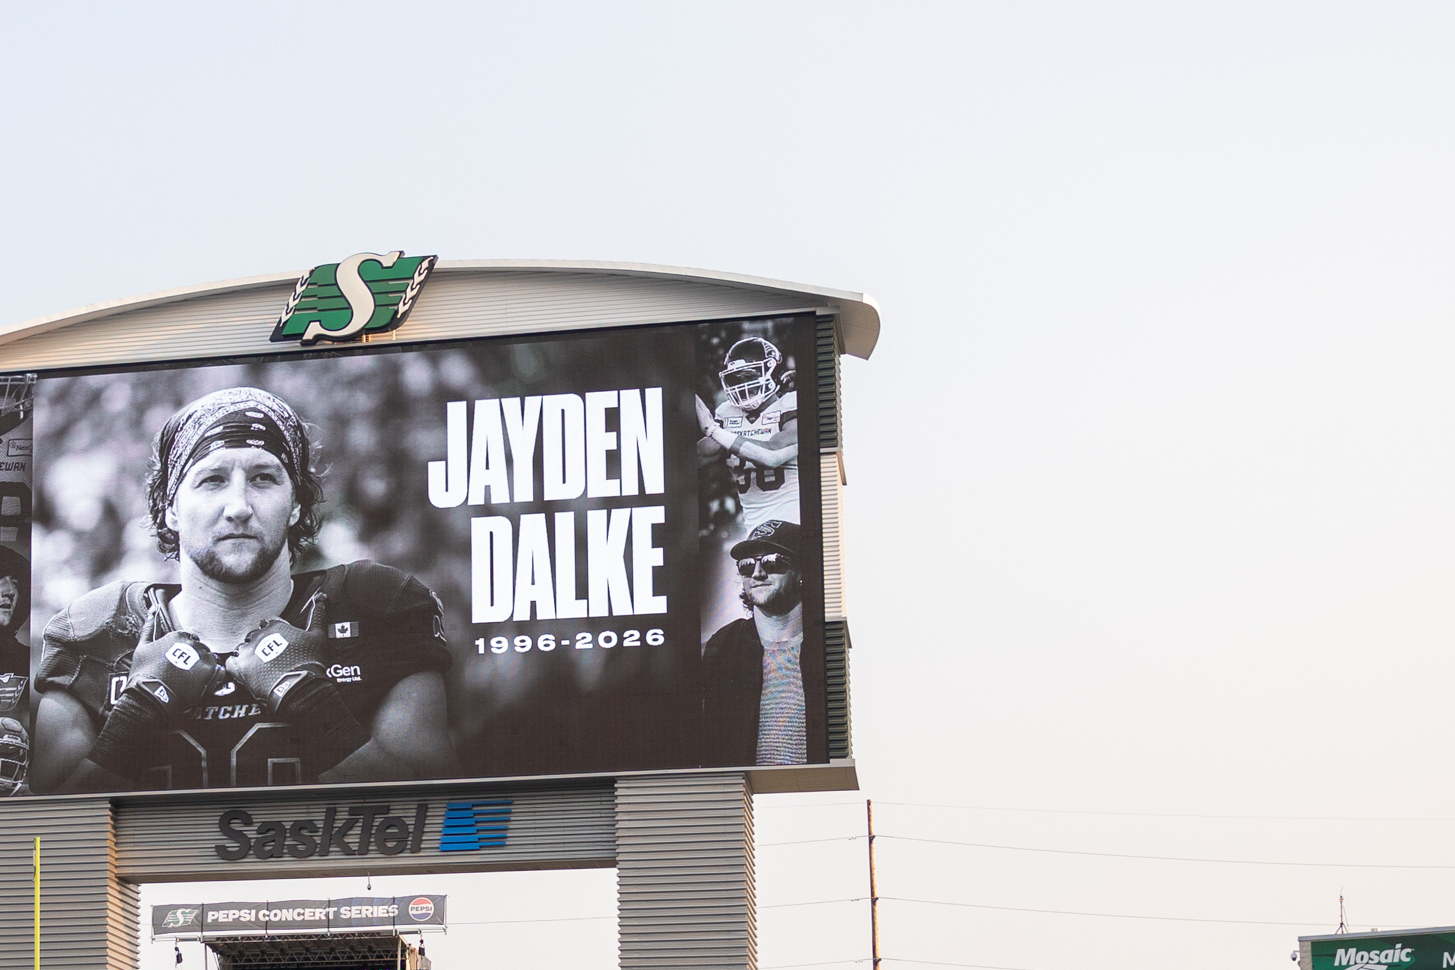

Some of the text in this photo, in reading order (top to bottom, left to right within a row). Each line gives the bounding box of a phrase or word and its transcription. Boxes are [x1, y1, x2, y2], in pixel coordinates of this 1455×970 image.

[428, 387, 665, 508] JAYDEN
[471, 506, 667, 623] DALKE
[260, 638, 282, 656] CFL
[474, 629, 665, 655] 1996-2026
[171, 647, 191, 666] CFL
[215, 803, 428, 861] SaskTel
[207, 910, 256, 923] PEPSI
[258, 907, 337, 922] CONCERT
[340, 905, 399, 919] SERIES
[1334, 943, 1412, 967] Mosaic
